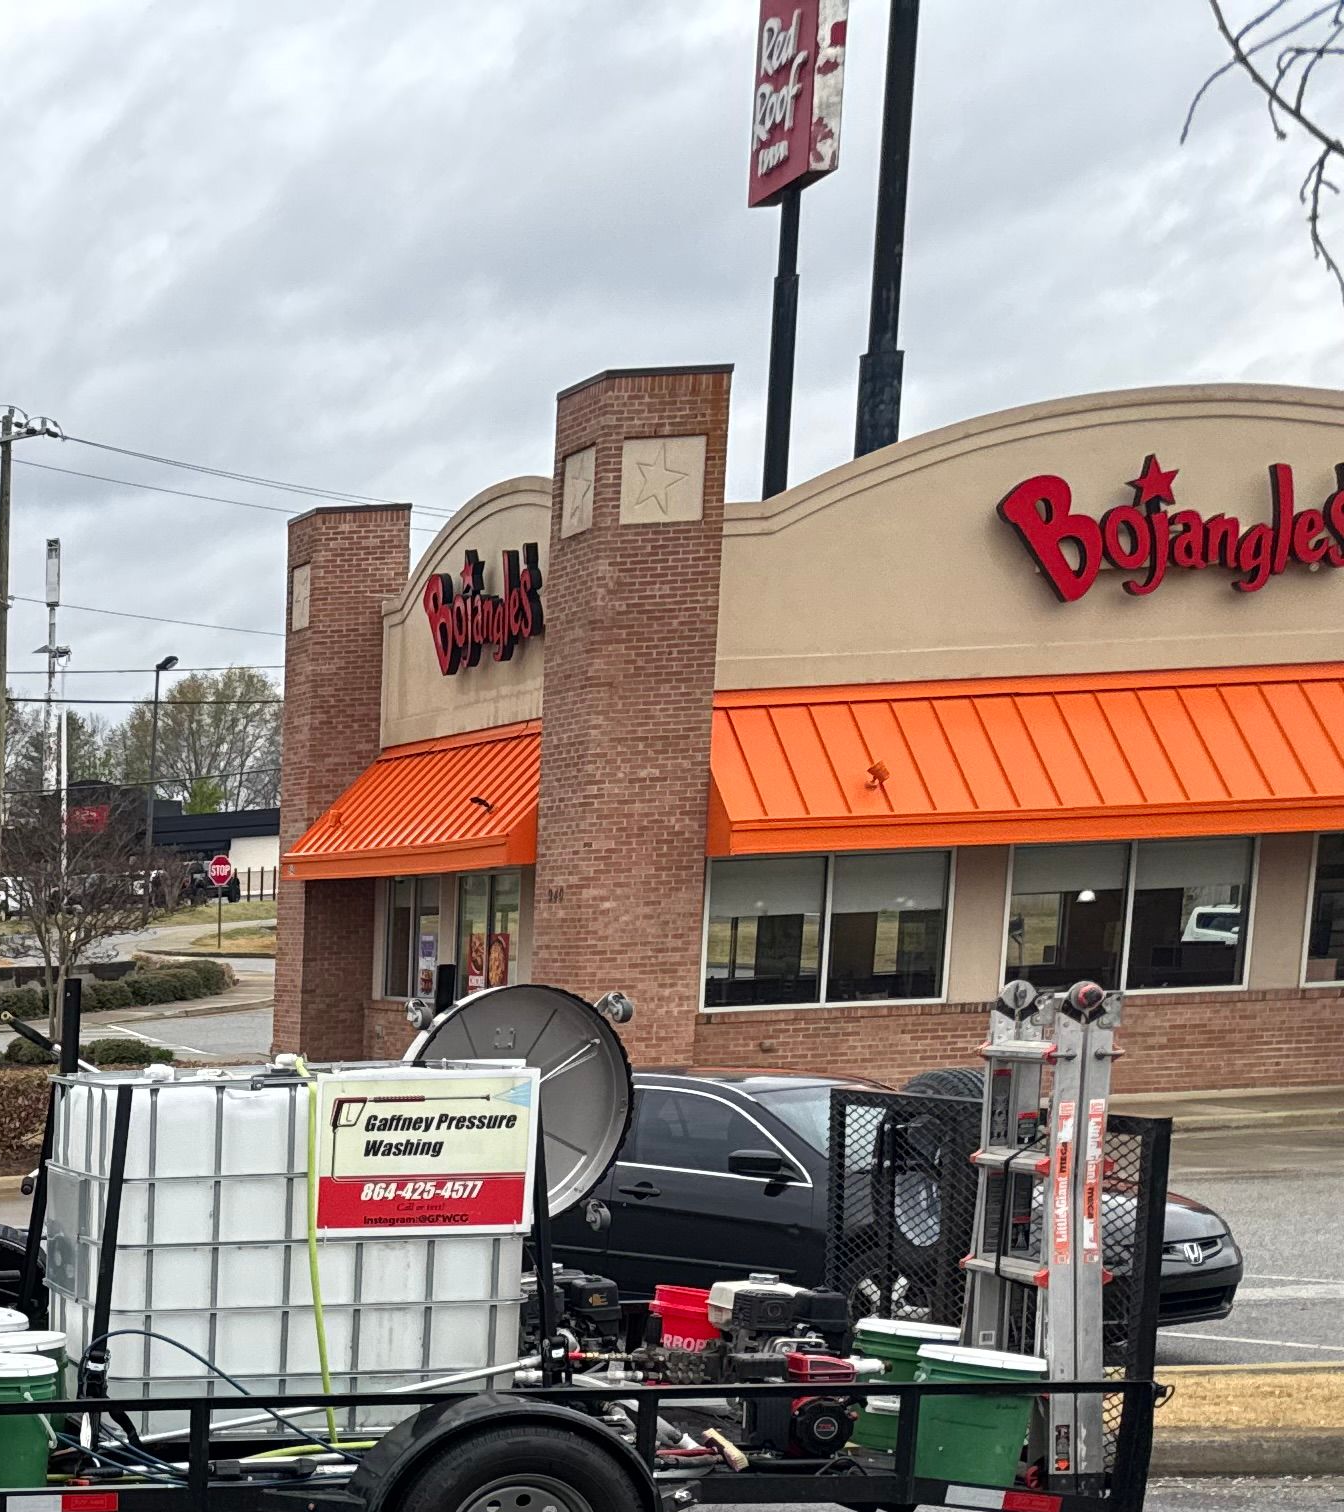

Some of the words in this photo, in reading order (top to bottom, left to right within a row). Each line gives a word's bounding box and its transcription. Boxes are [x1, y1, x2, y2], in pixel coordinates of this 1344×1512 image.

[761, 8, 801, 78] Red
[752, 50, 808, 152] Roof
[210, 863, 231, 876] STOP
[364, 1114, 435, 1133] Gaffney
[435, 1113, 518, 1131] Pressure
[363, 1138, 444, 1158] Washing
[360, 1180, 484, 1201] 864-425-4577
[396, 1202, 415, 1212] Call
